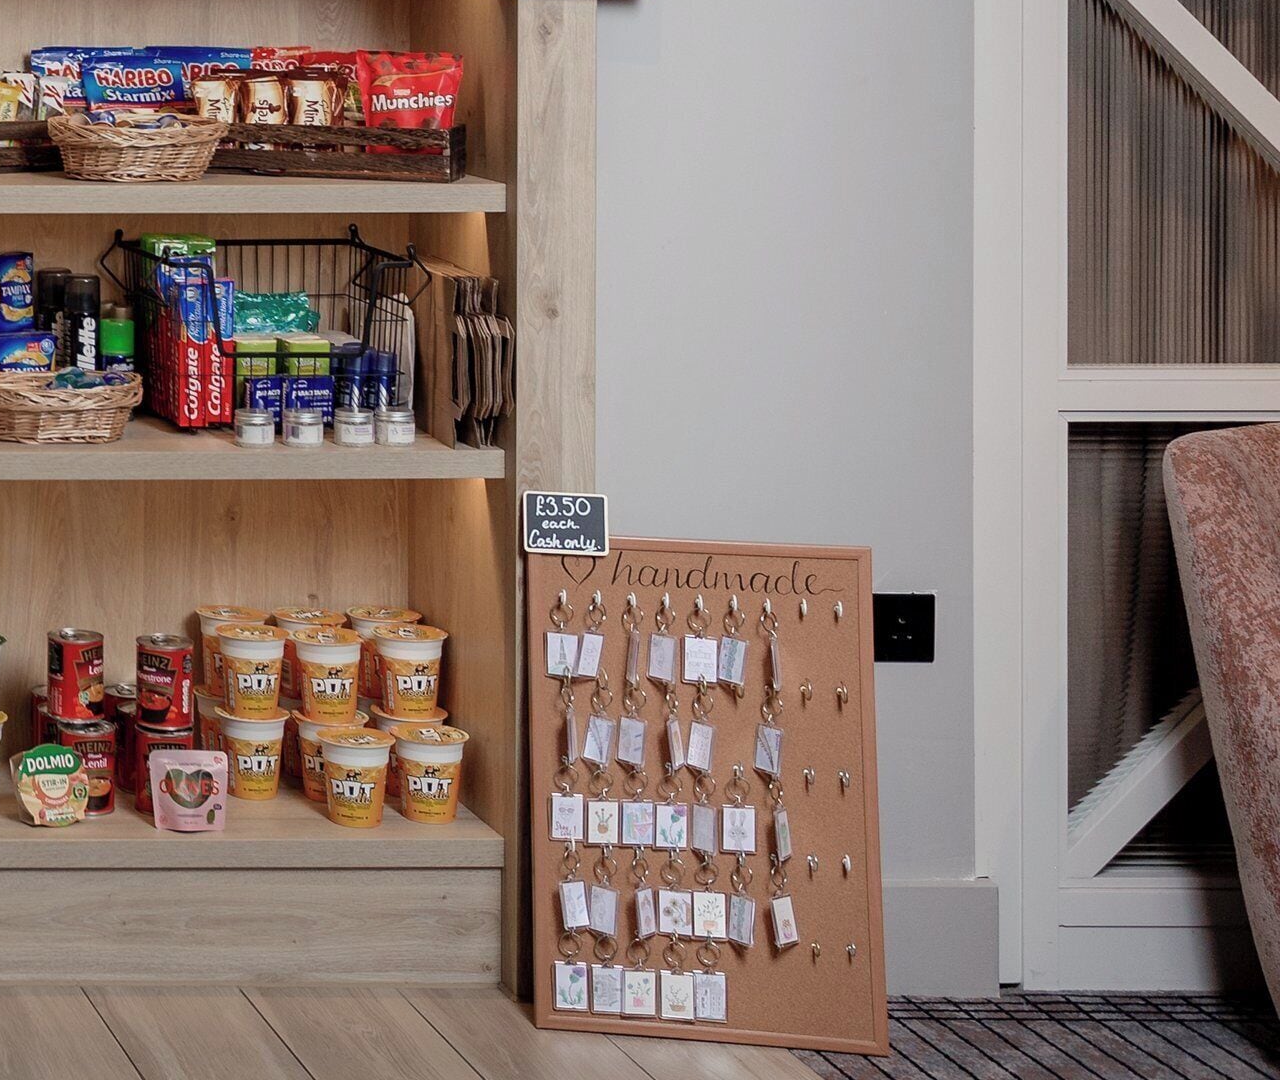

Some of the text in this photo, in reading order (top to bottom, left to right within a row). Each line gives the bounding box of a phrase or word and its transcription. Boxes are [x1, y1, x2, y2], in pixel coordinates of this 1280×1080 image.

[94, 66, 174, 88] HARIBO
[103, 87, 173, 103] Starmix
[371, 93, 454, 113] Munchies
[183, 347, 201, 420] Colgate
[207, 342, 224, 419] Colgate
[536, 496, 591, 516] £3.50
[528, 530, 563, 549] Cash
[611, 551, 844, 596] handmade
[237, 674, 278, 691] POT
[310, 677, 355, 694] POT
[395, 674, 439, 691] POT
[76, 741, 114, 753] HEINZ
[26, 754, 75, 771] DOLMIO
[81, 757, 108, 768] Lentil
[237, 754, 278, 771] POT
[41, 777, 68, 789] STIR-IN
[330, 778, 376, 797] POT
[407, 776, 453, 794] POT
